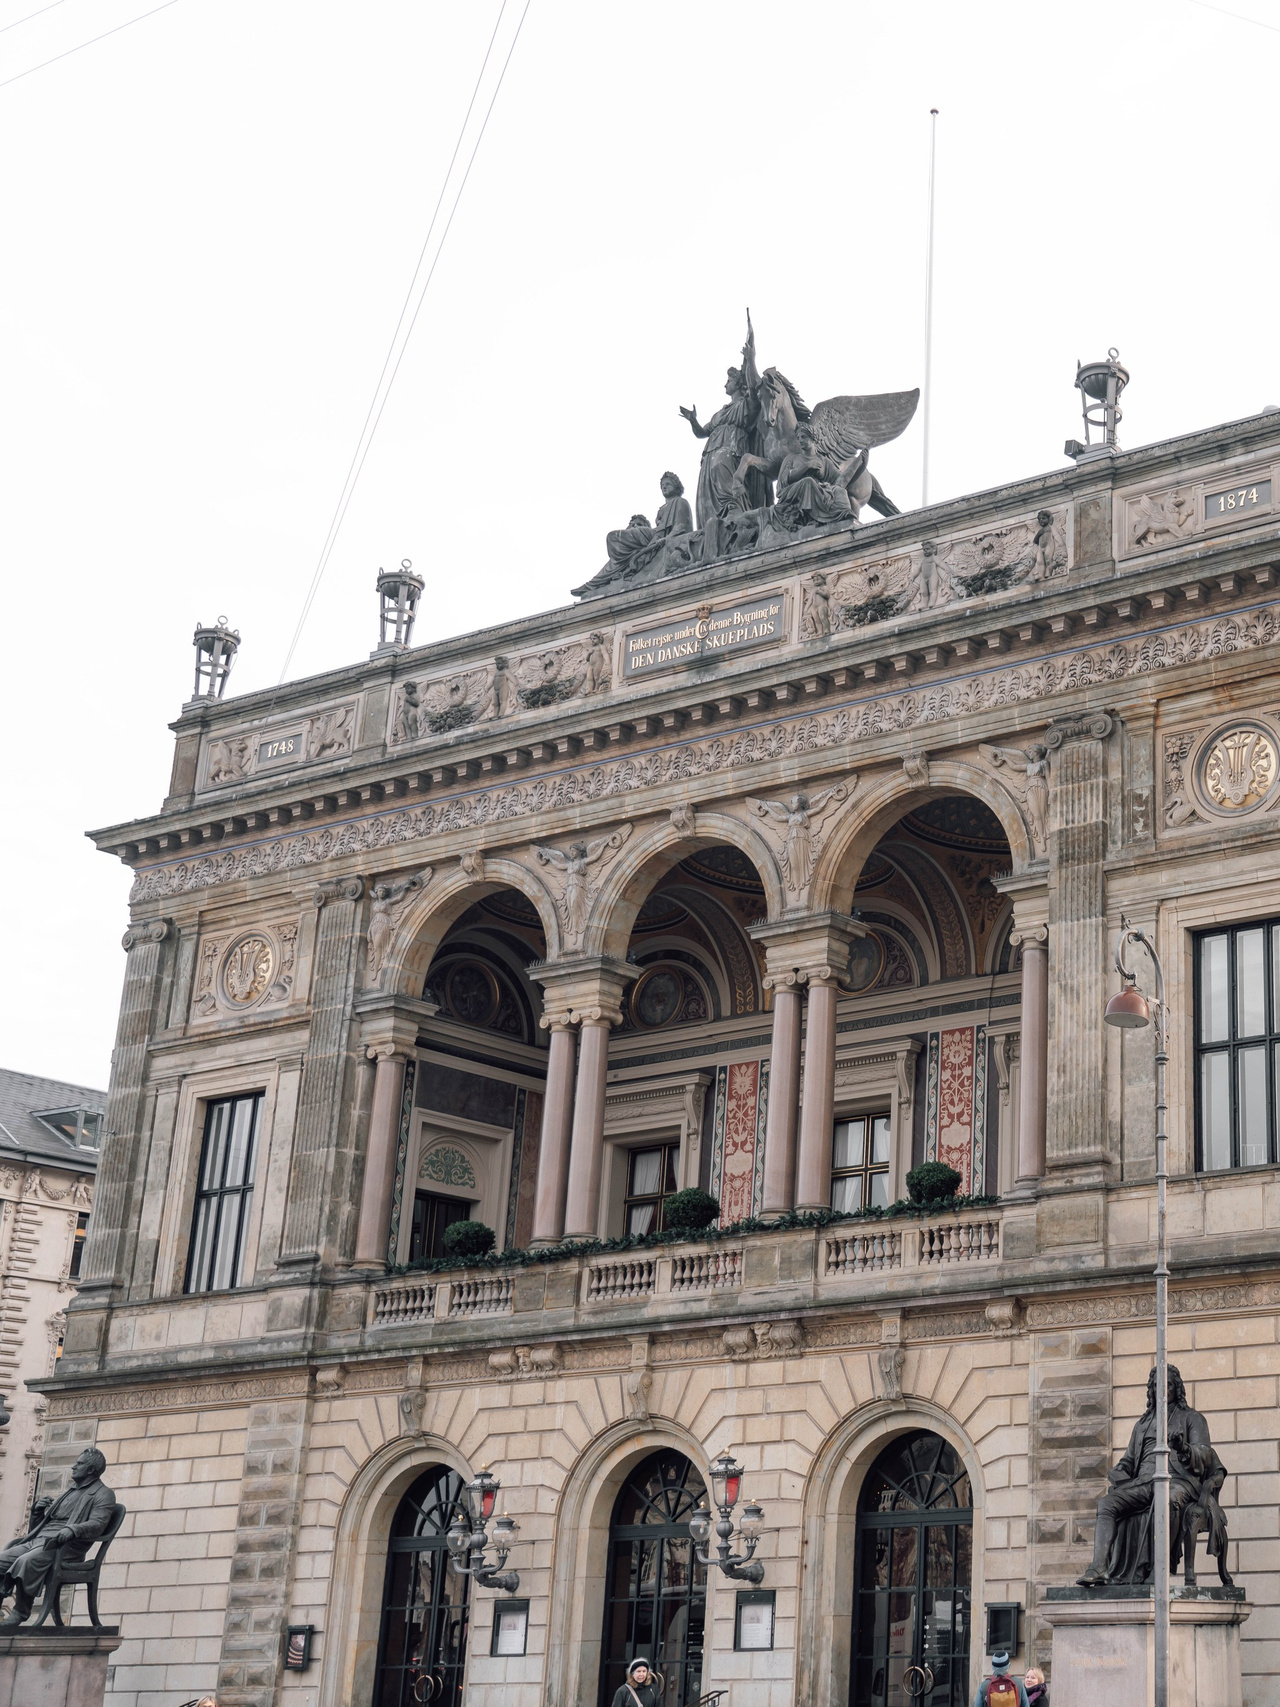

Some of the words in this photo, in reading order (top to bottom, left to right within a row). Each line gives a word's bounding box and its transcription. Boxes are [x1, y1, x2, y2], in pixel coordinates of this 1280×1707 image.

[1218, 488, 1258, 512] 1874
[629, 638, 652, 652] Folket
[652, 632, 674, 648] rejste
[674, 626, 696, 643] under
[709, 618, 732, 632] denne
[733, 610, 768, 628] Bygning
[769, 604, 780, 616] for
[632, 651, 656, 670] DEN
[658, 640, 702, 662] DANSKE
[705, 621, 775, 650] SKUEPLADS
[268, 739, 294, 758] 1748
